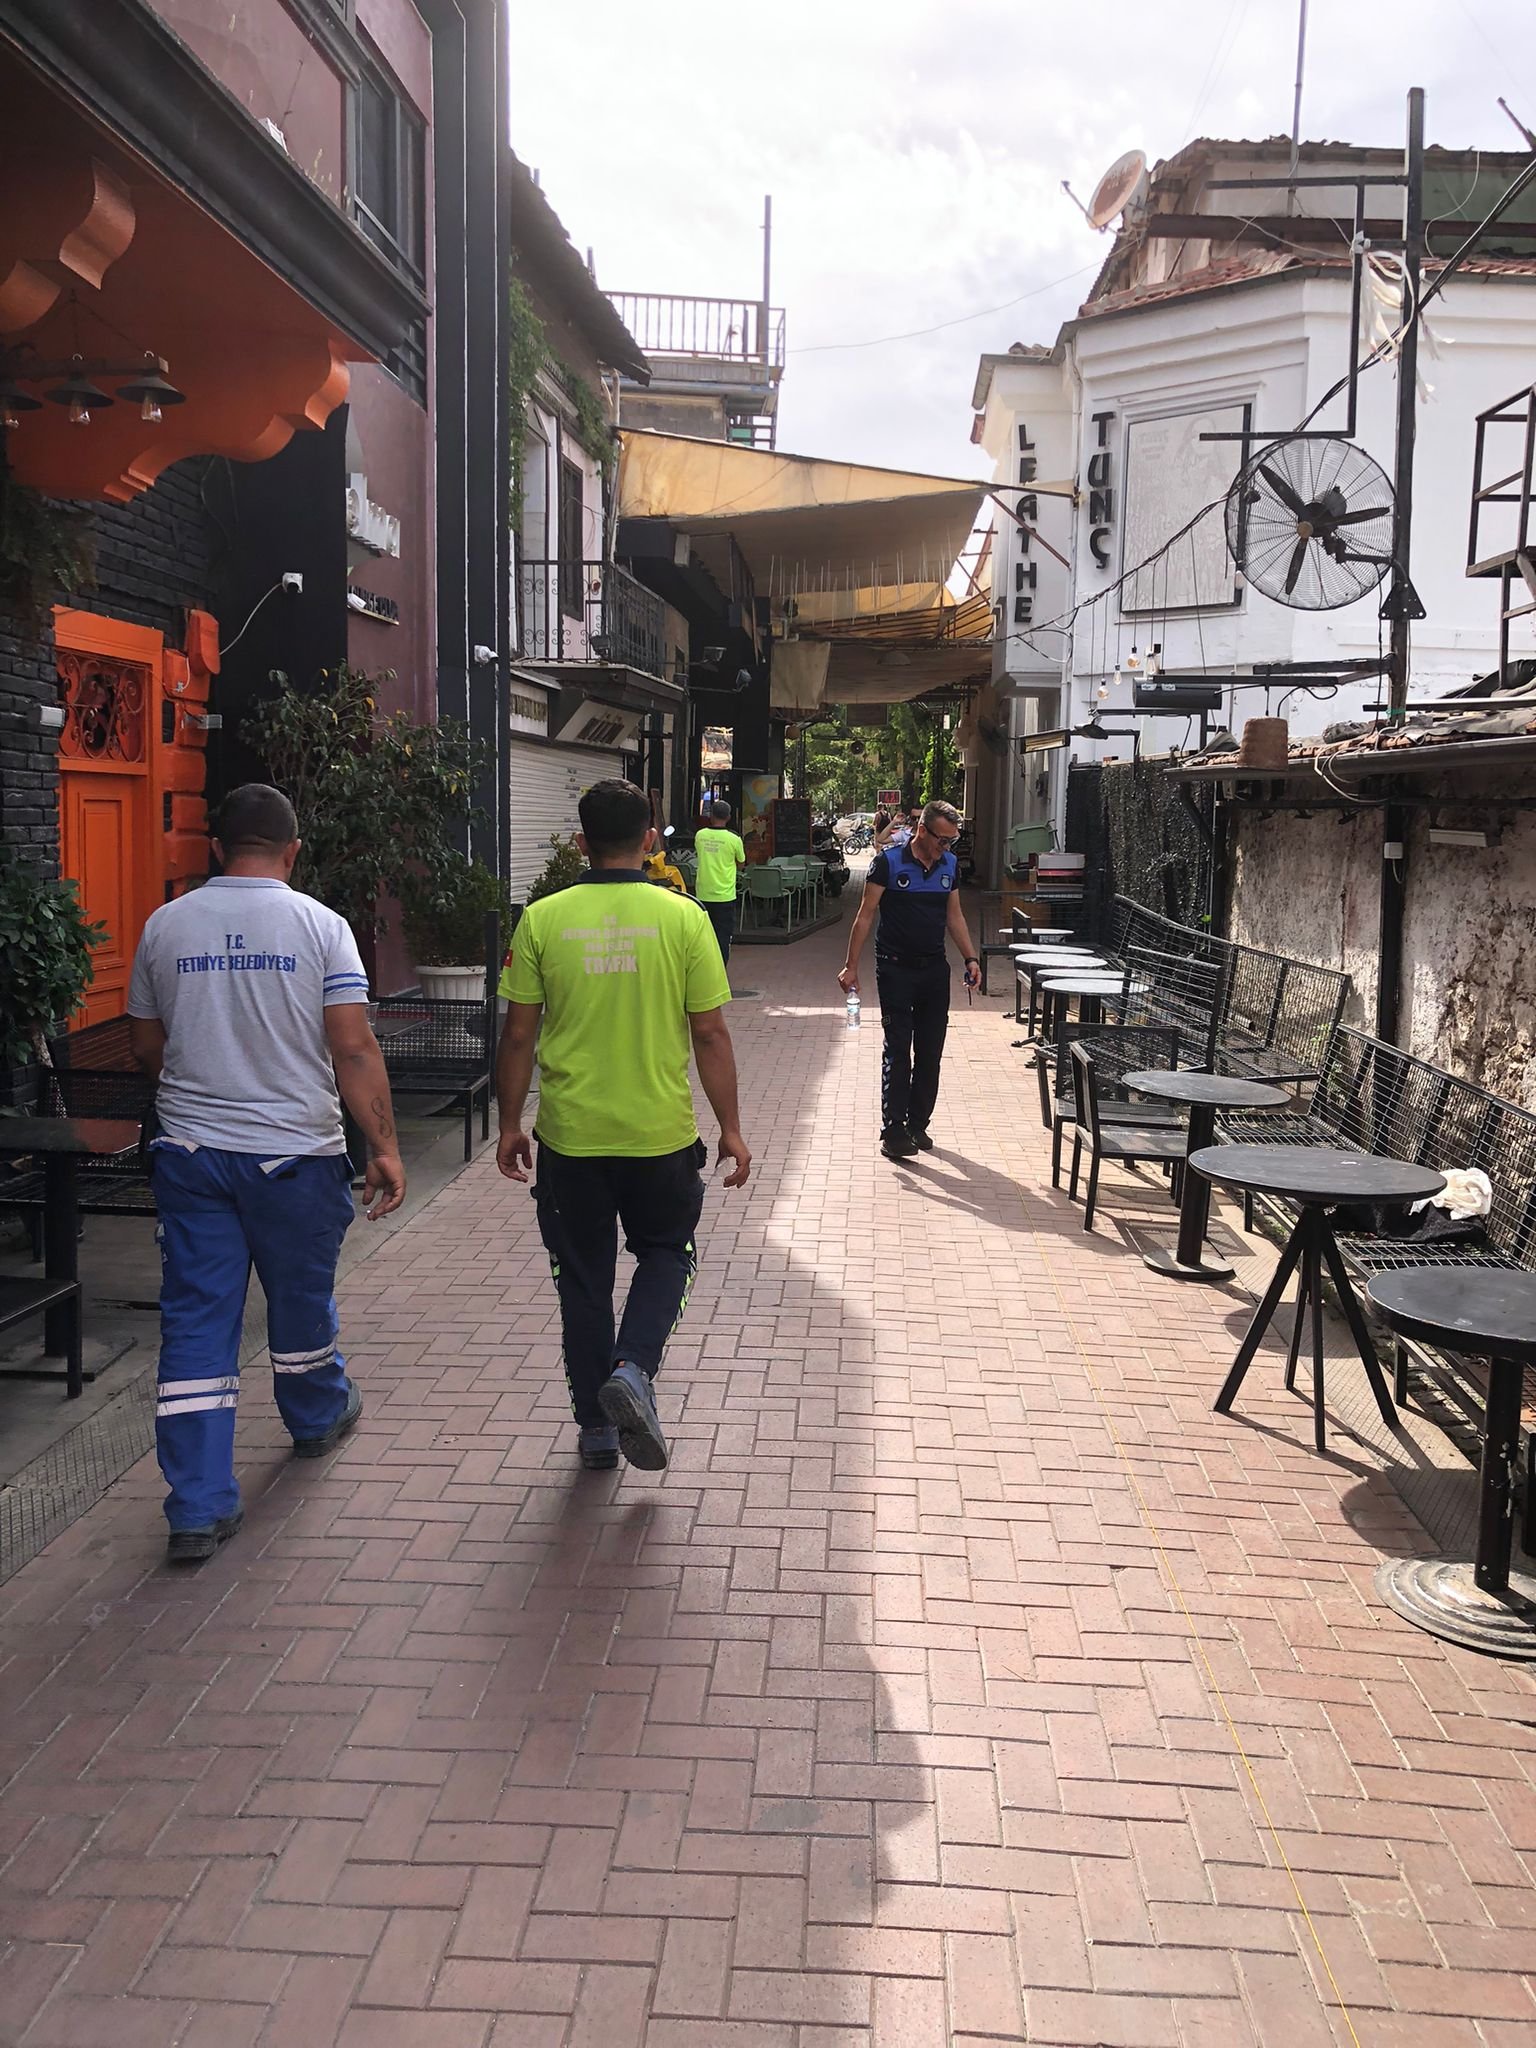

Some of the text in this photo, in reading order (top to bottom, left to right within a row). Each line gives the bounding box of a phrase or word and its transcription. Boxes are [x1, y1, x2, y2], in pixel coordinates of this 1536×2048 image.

[1014, 424, 1038, 623] LEATHE
[1087, 411, 1116, 570] TUNÇ
[176, 951, 297, 974] FETHİYE BELEDİYESİ
[225, 934, 246, 950] T.C.
